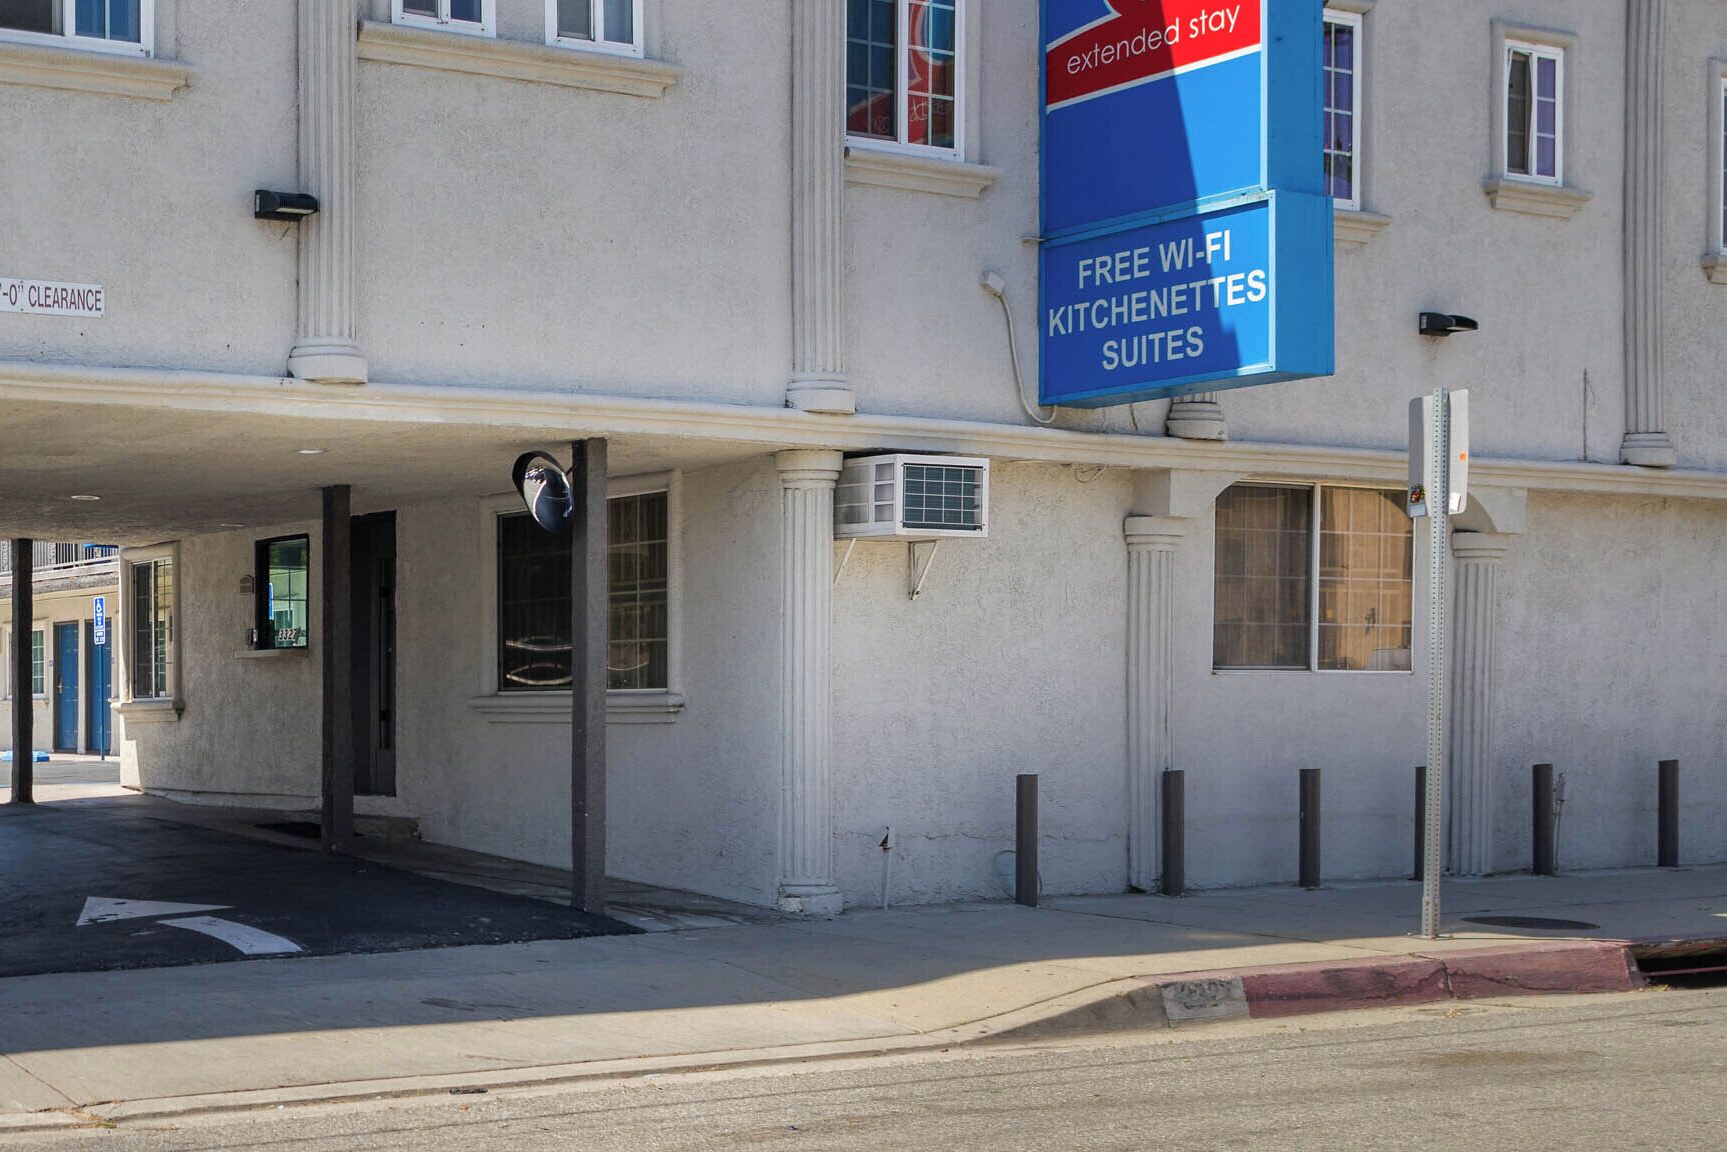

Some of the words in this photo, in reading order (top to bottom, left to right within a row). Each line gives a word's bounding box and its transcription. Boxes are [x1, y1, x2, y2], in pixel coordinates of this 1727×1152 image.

[1067, 17, 1180, 74] extended
[1188, 4, 1241, 39] stay
[1078, 246, 1150, 289] FREE
[1159, 229, 1231, 273] WI-FI
[28, 284, 102, 312] CLEARANCE
[1048, 268, 1266, 337] KITCHENETTES
[1102, 326, 1205, 370] SUITES
